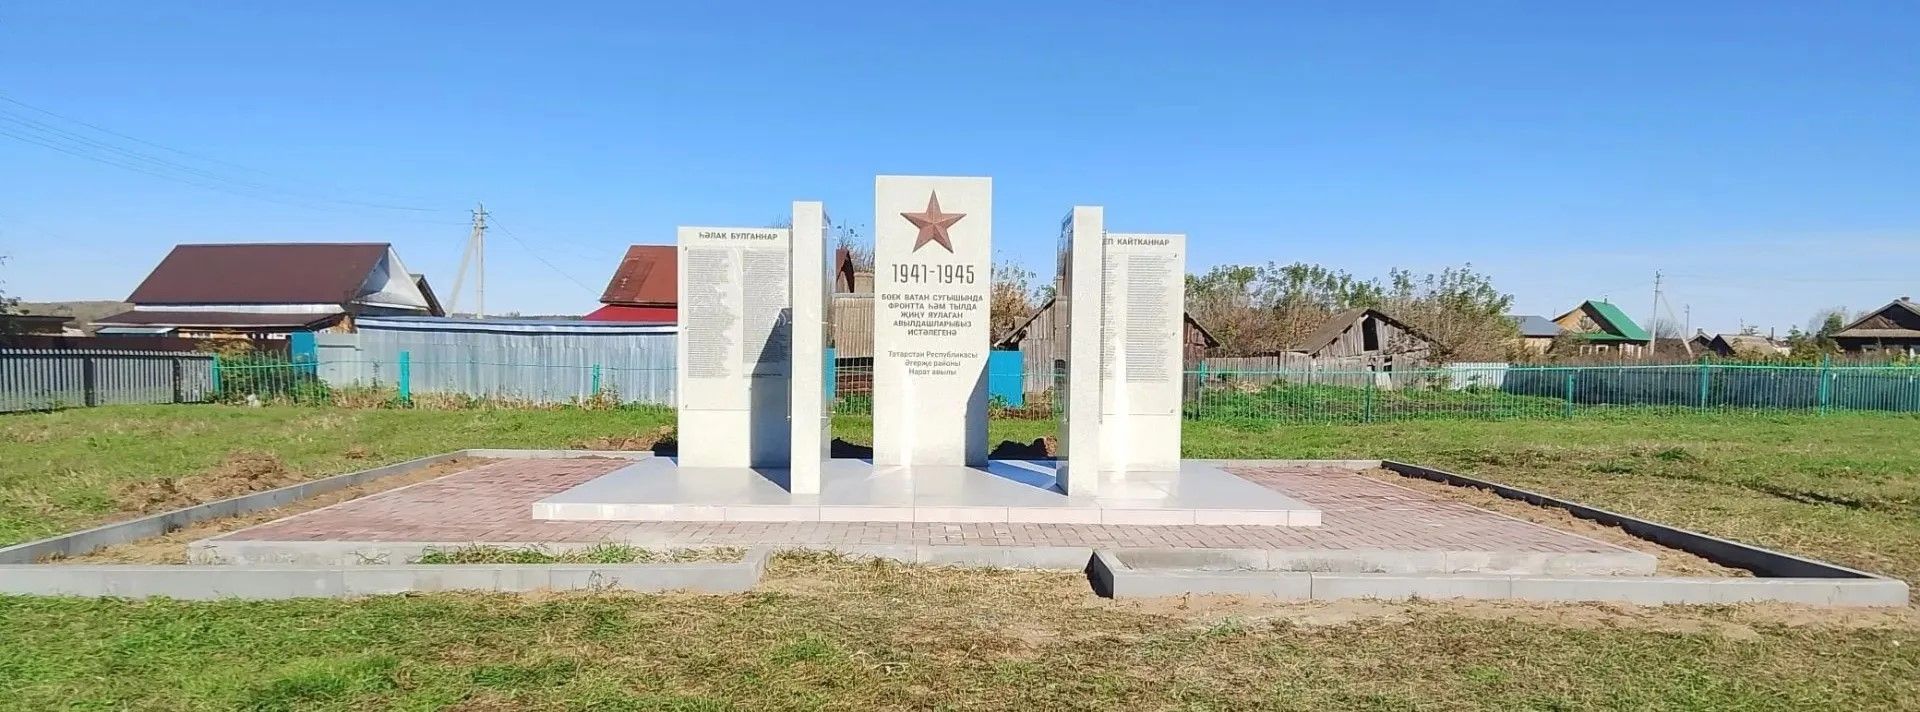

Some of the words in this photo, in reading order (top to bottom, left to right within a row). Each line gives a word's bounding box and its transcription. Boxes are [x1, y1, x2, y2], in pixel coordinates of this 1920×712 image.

[699, 231, 727, 239] ҺӘЛАК
[730, 232, 778, 240] БУЛГАННАР
[1117, 237, 1170, 246] КАЙТКАННАР
[892, 263, 975, 284] 1941-1945
[932, 294, 983, 302] СУГЫШЫНДА
[888, 302, 925, 310] ФРОНТТА
[888, 350, 925, 358] Татарстан
[926, 350, 978, 359] Республикасы
[933, 359, 961, 367] районы
[908, 368, 930, 376] Нарат
